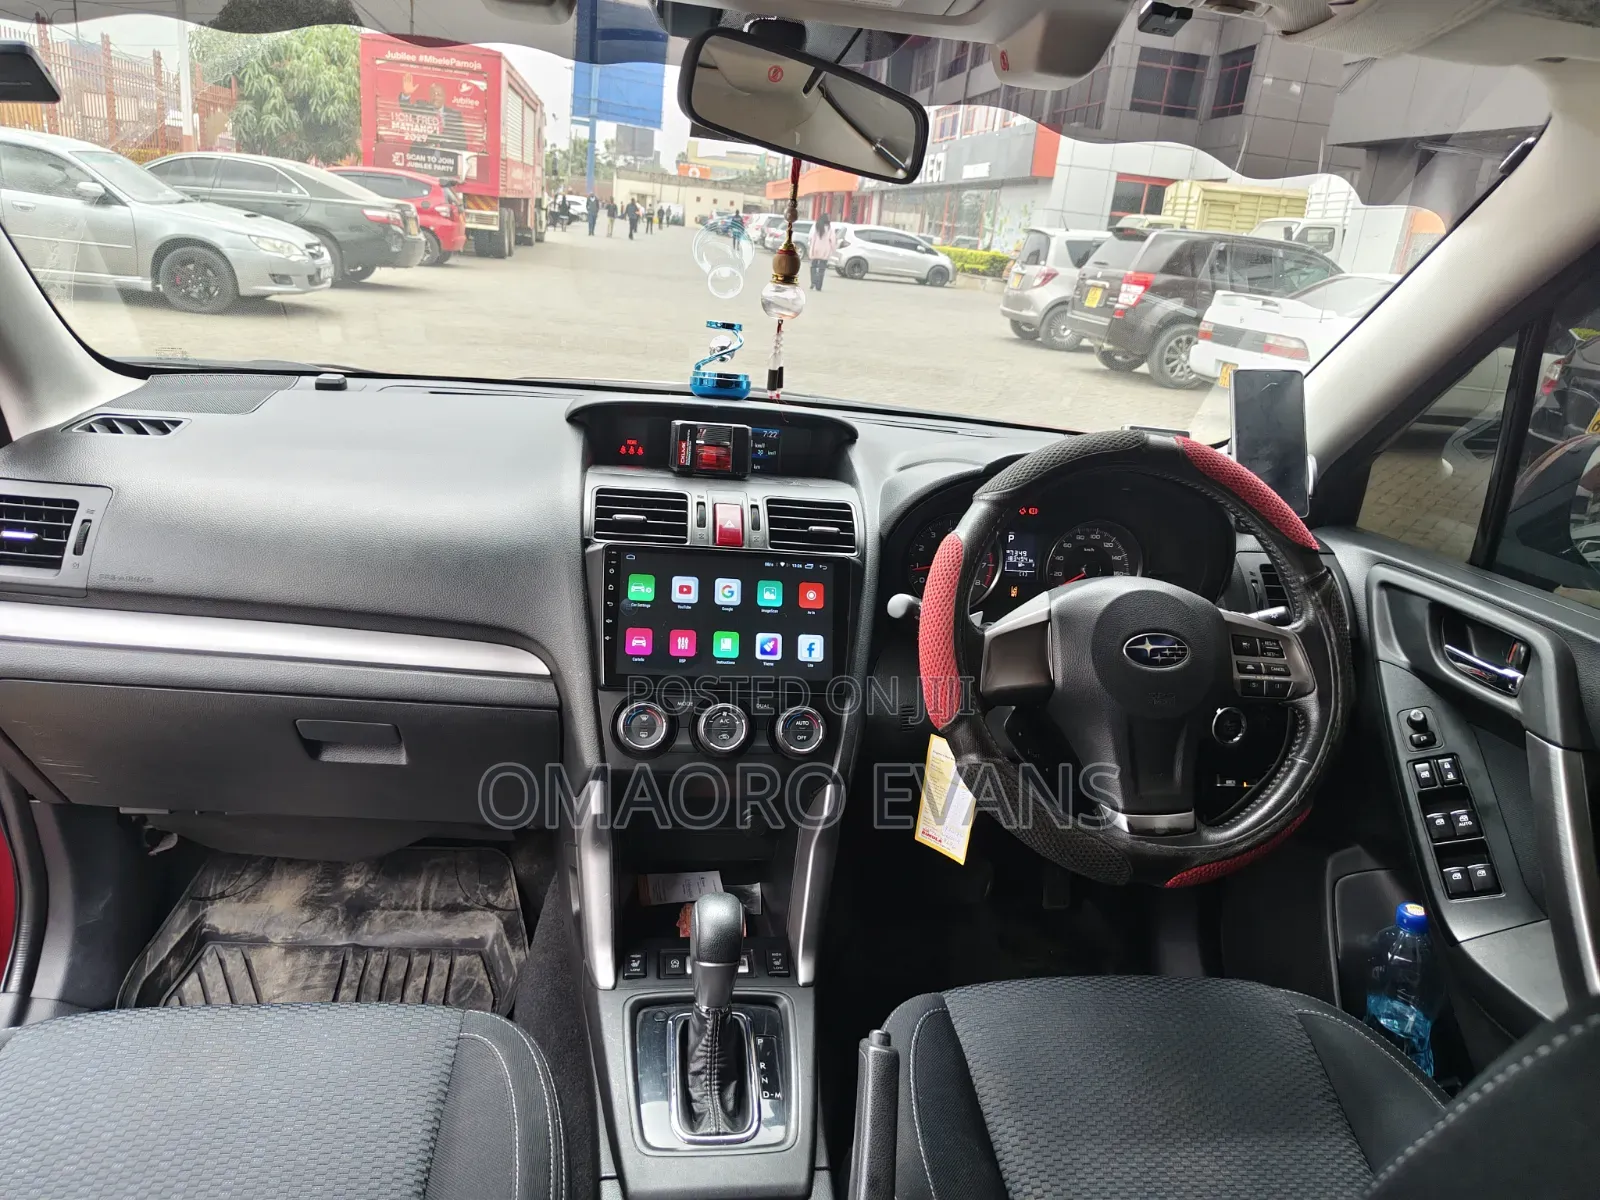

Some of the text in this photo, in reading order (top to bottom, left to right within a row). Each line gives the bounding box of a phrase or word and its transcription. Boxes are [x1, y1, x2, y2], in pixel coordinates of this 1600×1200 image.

[385, 50, 417, 61] Jubilee
[418, 54, 482, 70] #MbelePamoja
[452, 96, 480, 106] Jubilee
[1008, 535, 1014, 543] P
